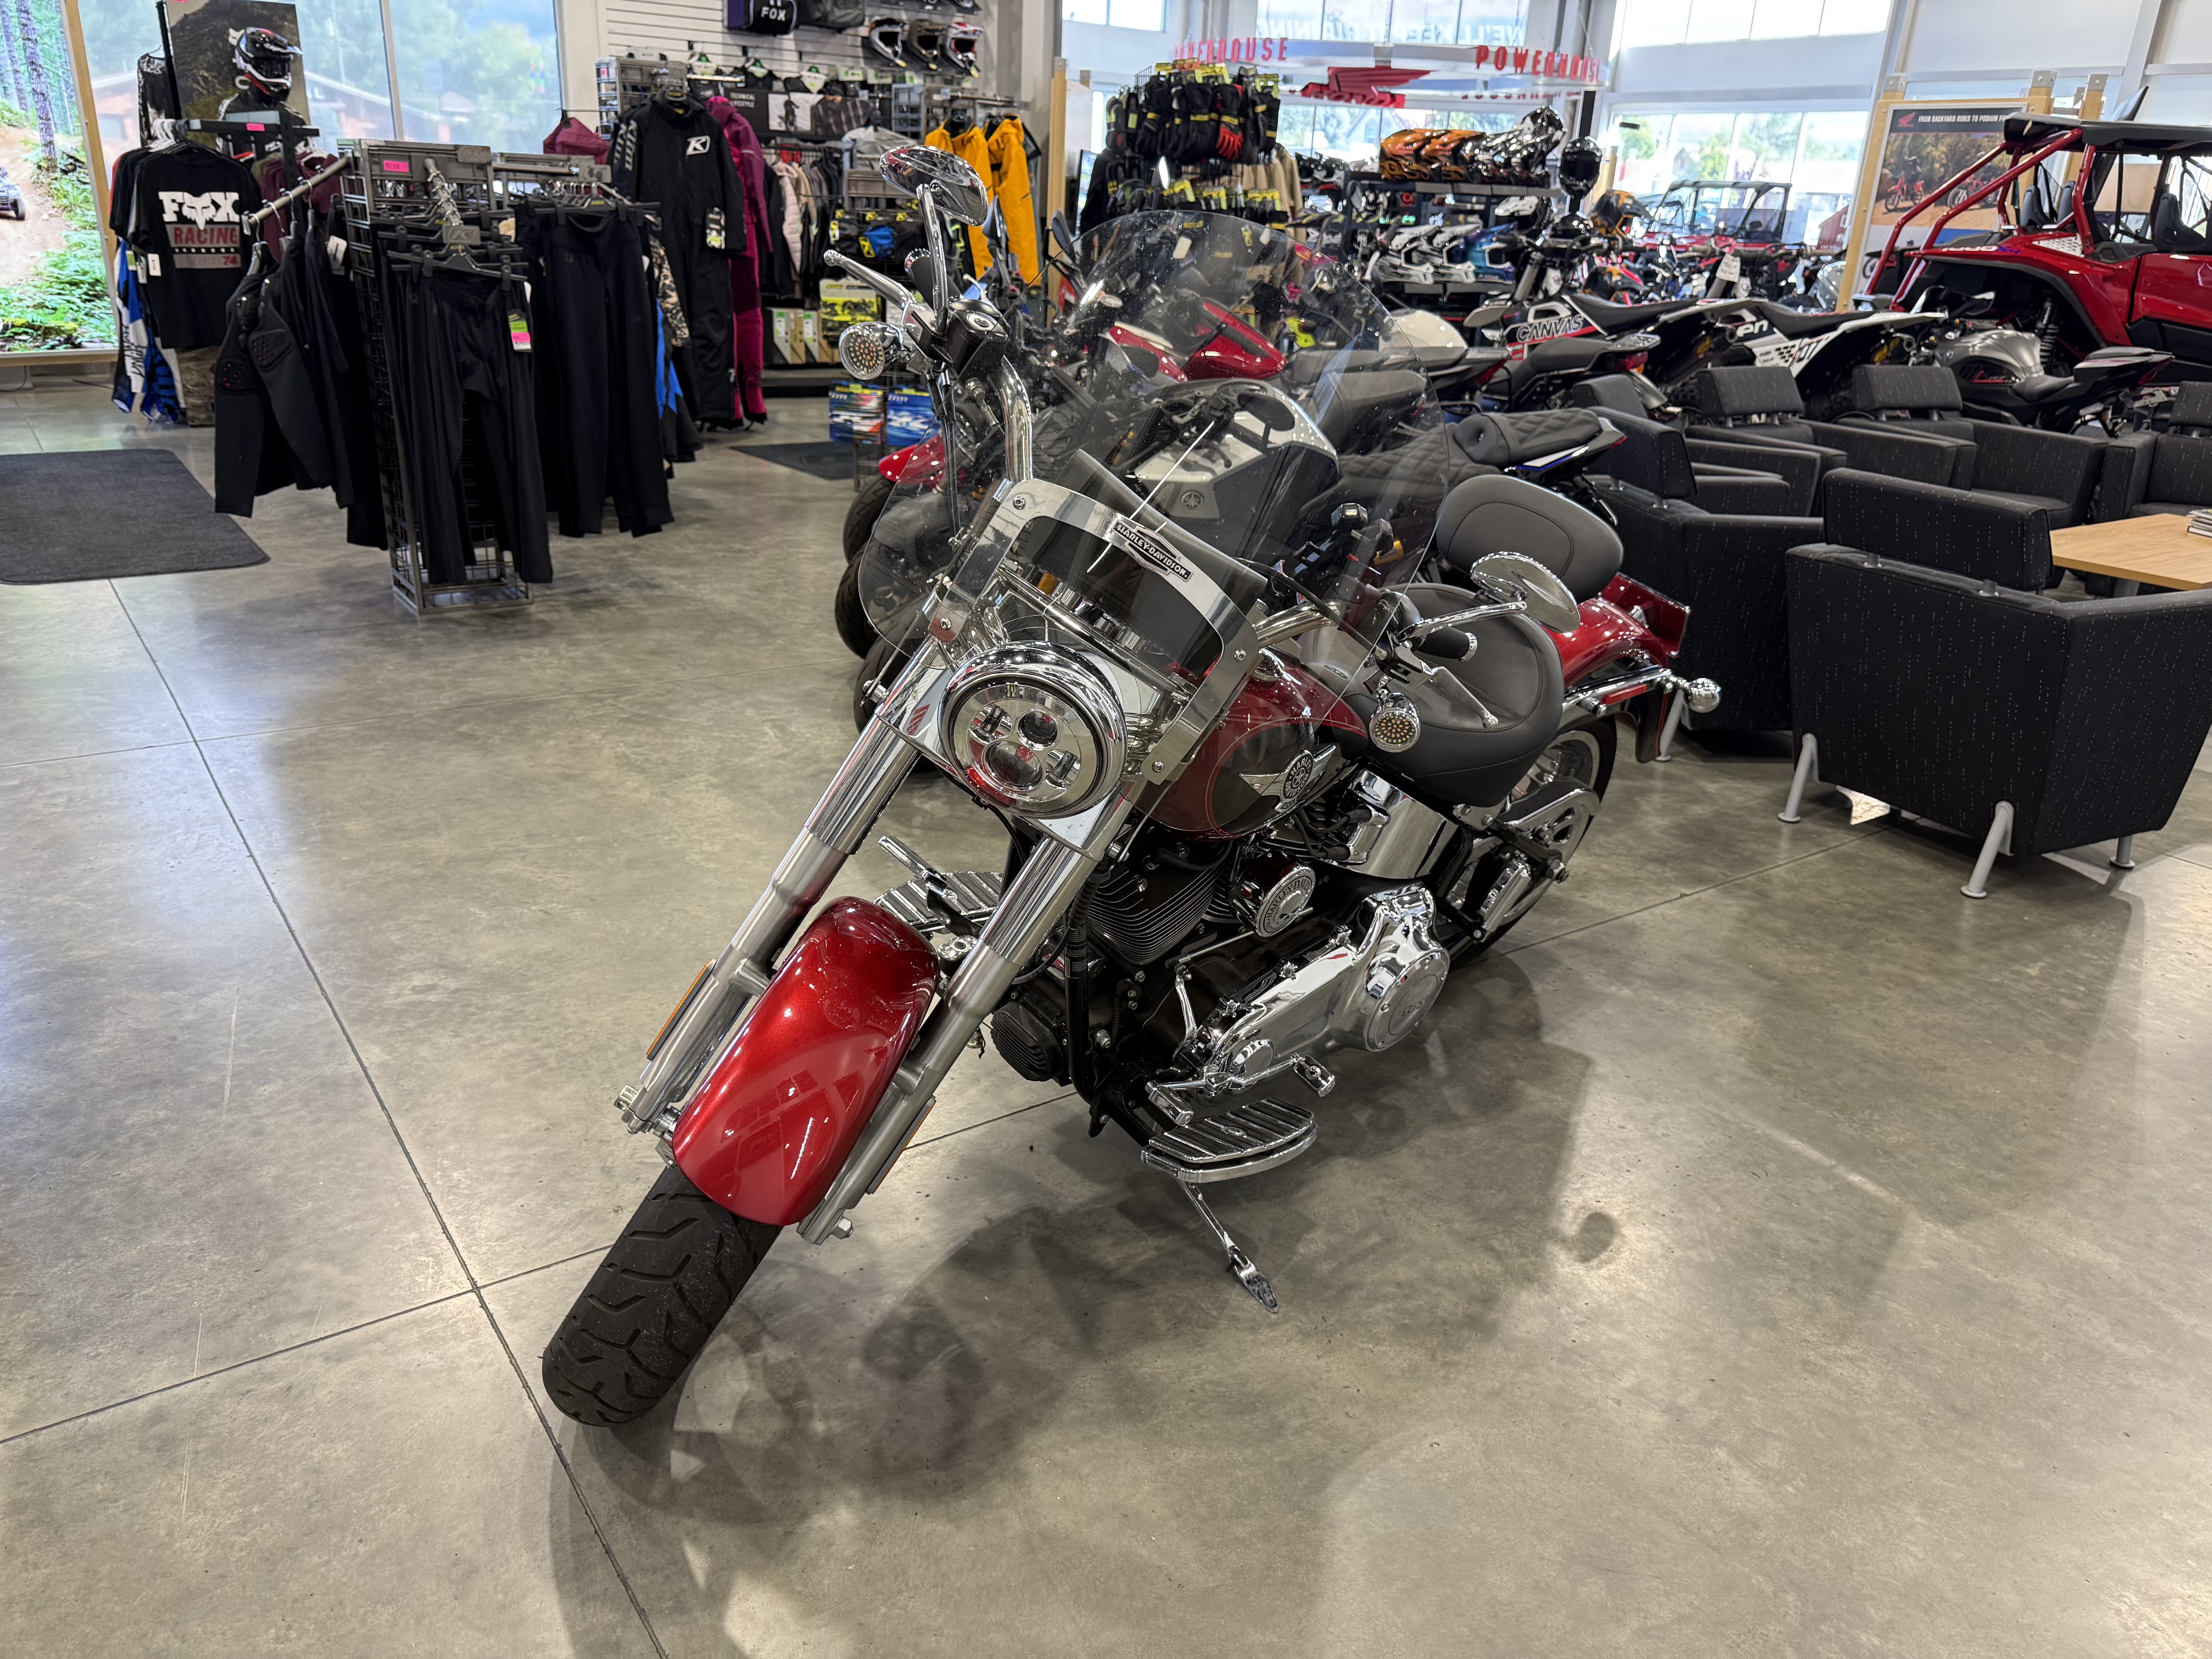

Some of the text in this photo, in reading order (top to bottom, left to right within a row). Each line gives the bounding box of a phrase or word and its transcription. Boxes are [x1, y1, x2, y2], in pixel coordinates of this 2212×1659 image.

[761, 6, 786, 22] FOX
[174, 227, 239, 245] RACING
[223, 256, 238, 266] 74
[1516, 313, 1584, 343] CANVAS
[1285, 773, 1309, 797] DAVIDSON
